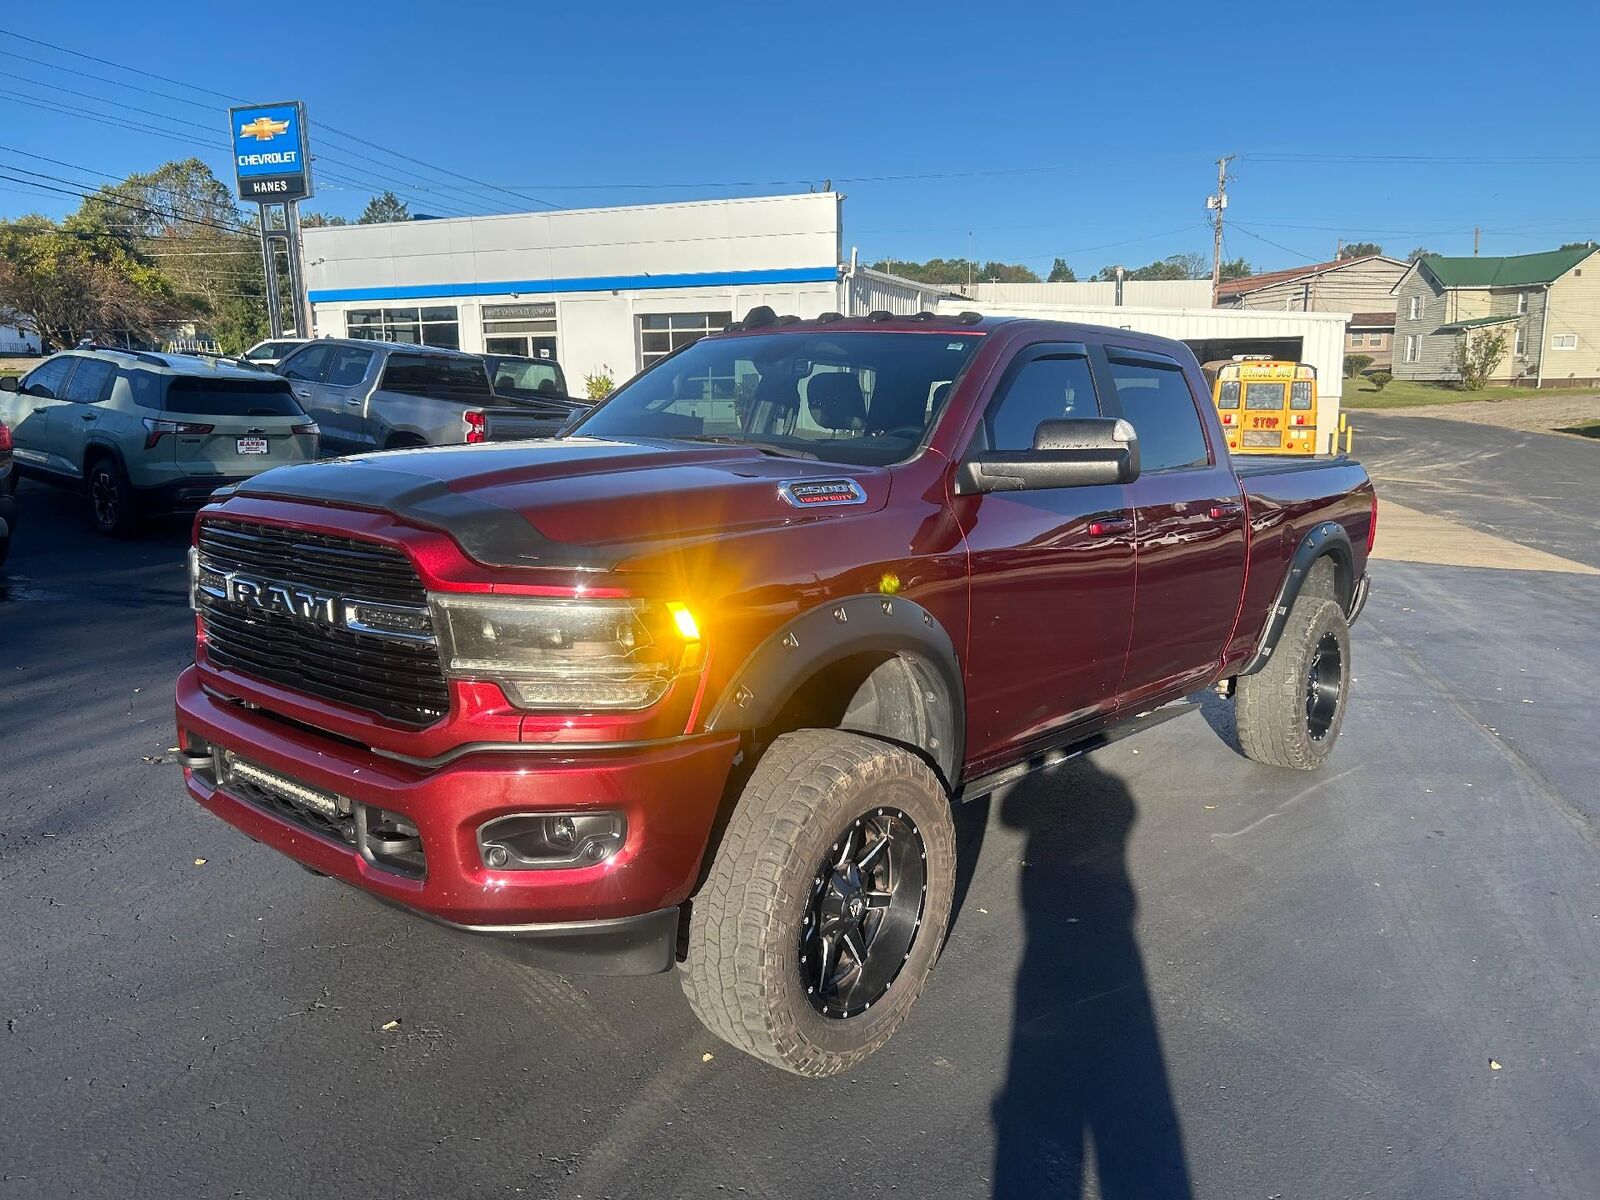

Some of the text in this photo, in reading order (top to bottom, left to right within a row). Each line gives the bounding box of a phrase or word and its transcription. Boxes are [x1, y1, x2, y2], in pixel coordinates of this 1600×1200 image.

[238, 151, 296, 166] CHEVROLET
[253, 180, 288, 193] HANES
[1243, 367, 1292, 378] SCHOOL BUS
[1252, 417, 1279, 429] STOP
[794, 484, 849, 495] 2500
[232, 576, 335, 624] RAM
